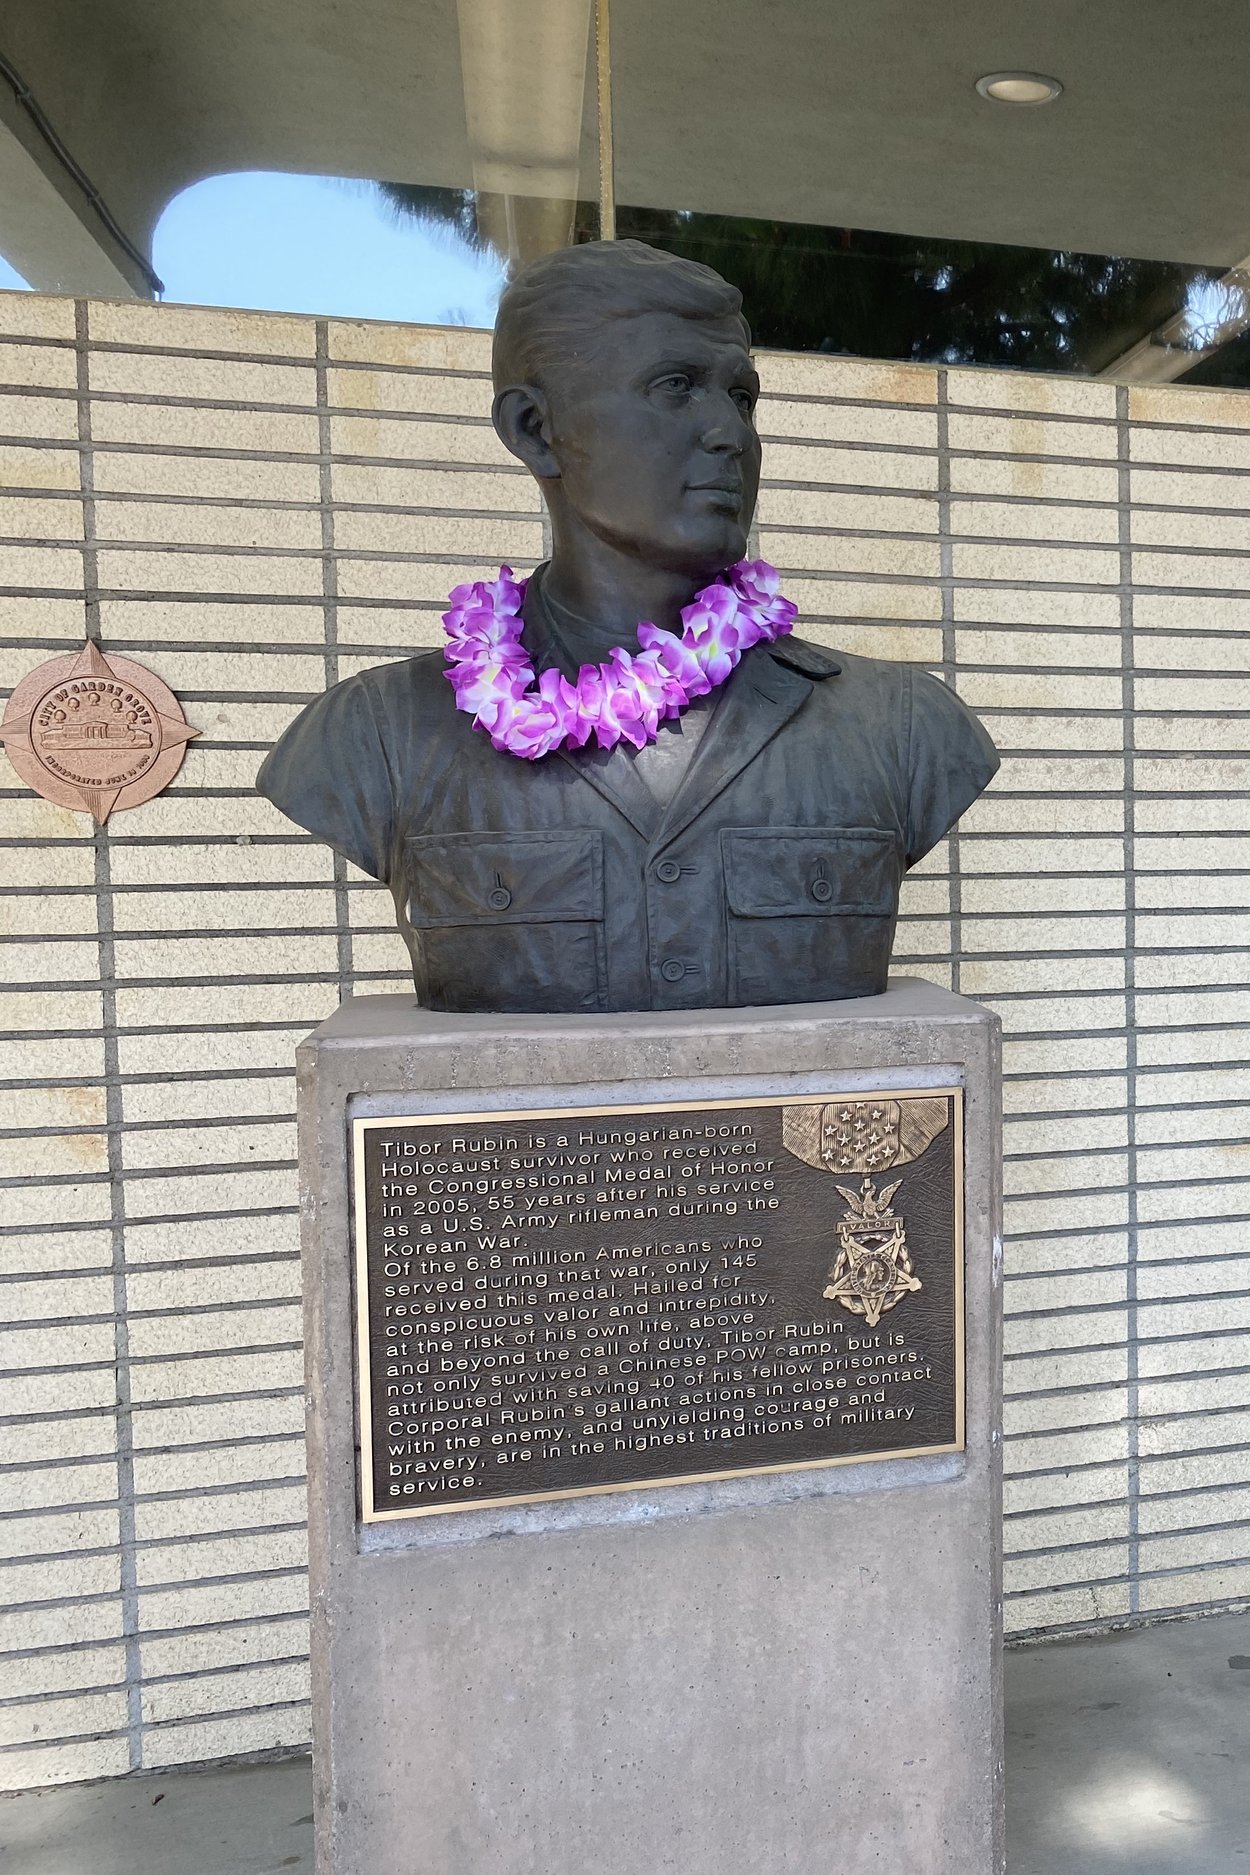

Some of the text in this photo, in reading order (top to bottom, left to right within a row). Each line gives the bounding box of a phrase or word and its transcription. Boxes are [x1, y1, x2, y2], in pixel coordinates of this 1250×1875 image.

[39, 681, 152, 726] CITY OF GARDEN GROVE
[380, 1123, 752, 1156] Tibor Rubin is a Hungarian-born
[380, 1141, 756, 1176] Holocaust survivor who received
[381, 1161, 774, 1196] the Congressional Medal of Honor
[381, 1179, 774, 1217] in 2005, 55 years after his service
[382, 1196, 779, 1237] as a U.S. Army rifleman during the
[849, 1220, 891, 1230] VALOR
[383, 1235, 762, 1277] Of the 6.8 million Americans who
[384, 1234, 527, 1257] Korean War.
[384, 1254, 756, 1297] served during that war, only 145
[384, 1275, 740, 1317] received this medal. Hailed for
[384, 1292, 775, 1337] conspicuous valor and intrepidity,
[385, 1342, 407, 1357] at
[416, 1338, 453, 1354] the
[463, 1332, 504, 1349] risk
[514, 1329, 536, 1345] of
[544, 1327, 577, 1342] his
[586, 1324, 629, 1338] own
[689, 1312, 754, 1328] above
[386, 1321, 843, 1377] and beyond the call of duty, Tibor Rubin
[386, 1333, 905, 1397] not only survived a Chinese POW camp, but is
[387, 1352, 924, 1417] attributed with saving 40 of his fellow prisoners.
[387, 1367, 931, 1437] Corporal Rubin's gallant actions in close contact
[388, 1389, 885, 1457] with the enemy, and unyielding courage and
[389, 1407, 914, 1477] bravery, are in the highest traditions of military
[389, 1475, 481, 1497] service.
